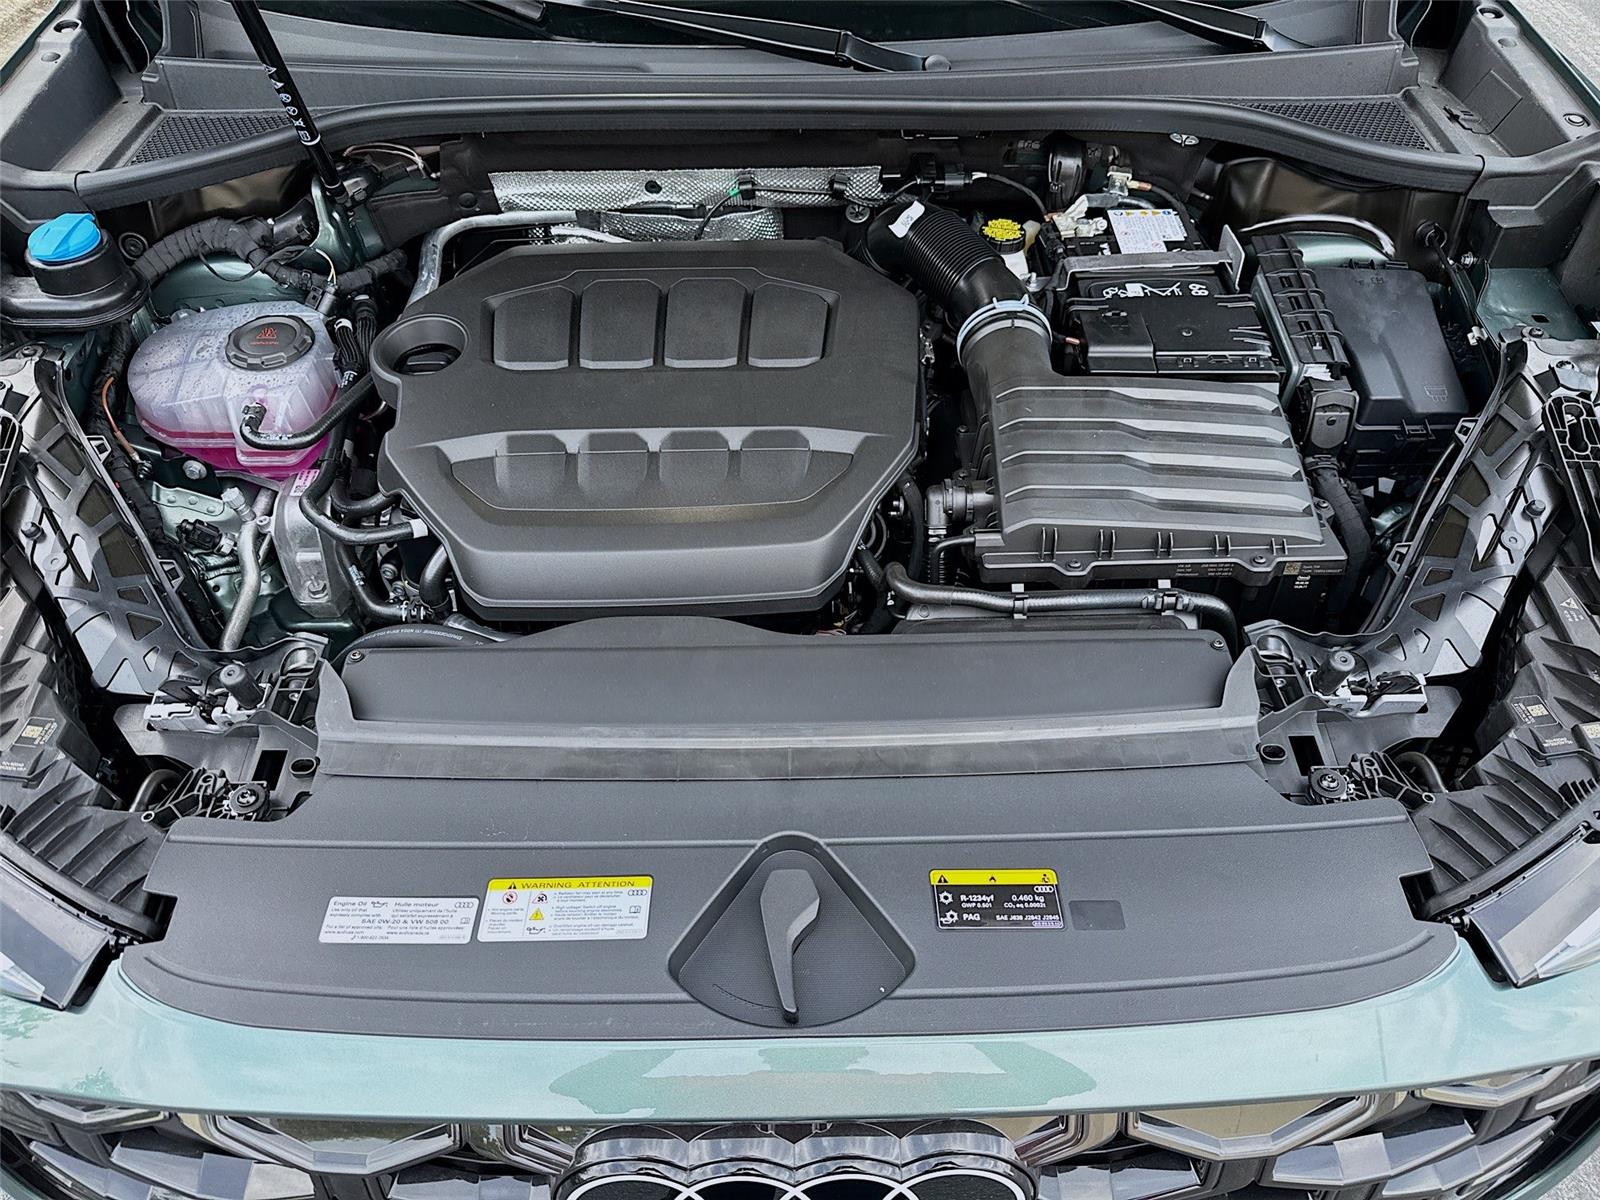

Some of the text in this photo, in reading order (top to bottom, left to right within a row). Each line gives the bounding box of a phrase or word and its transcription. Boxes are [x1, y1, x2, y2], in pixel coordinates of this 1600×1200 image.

[521, 880, 636, 889] WARNING ATTENTION
[960, 894, 994, 903] R-1234yf
[1034, 894, 1045, 903] kg
[962, 913, 981, 921] PAG
